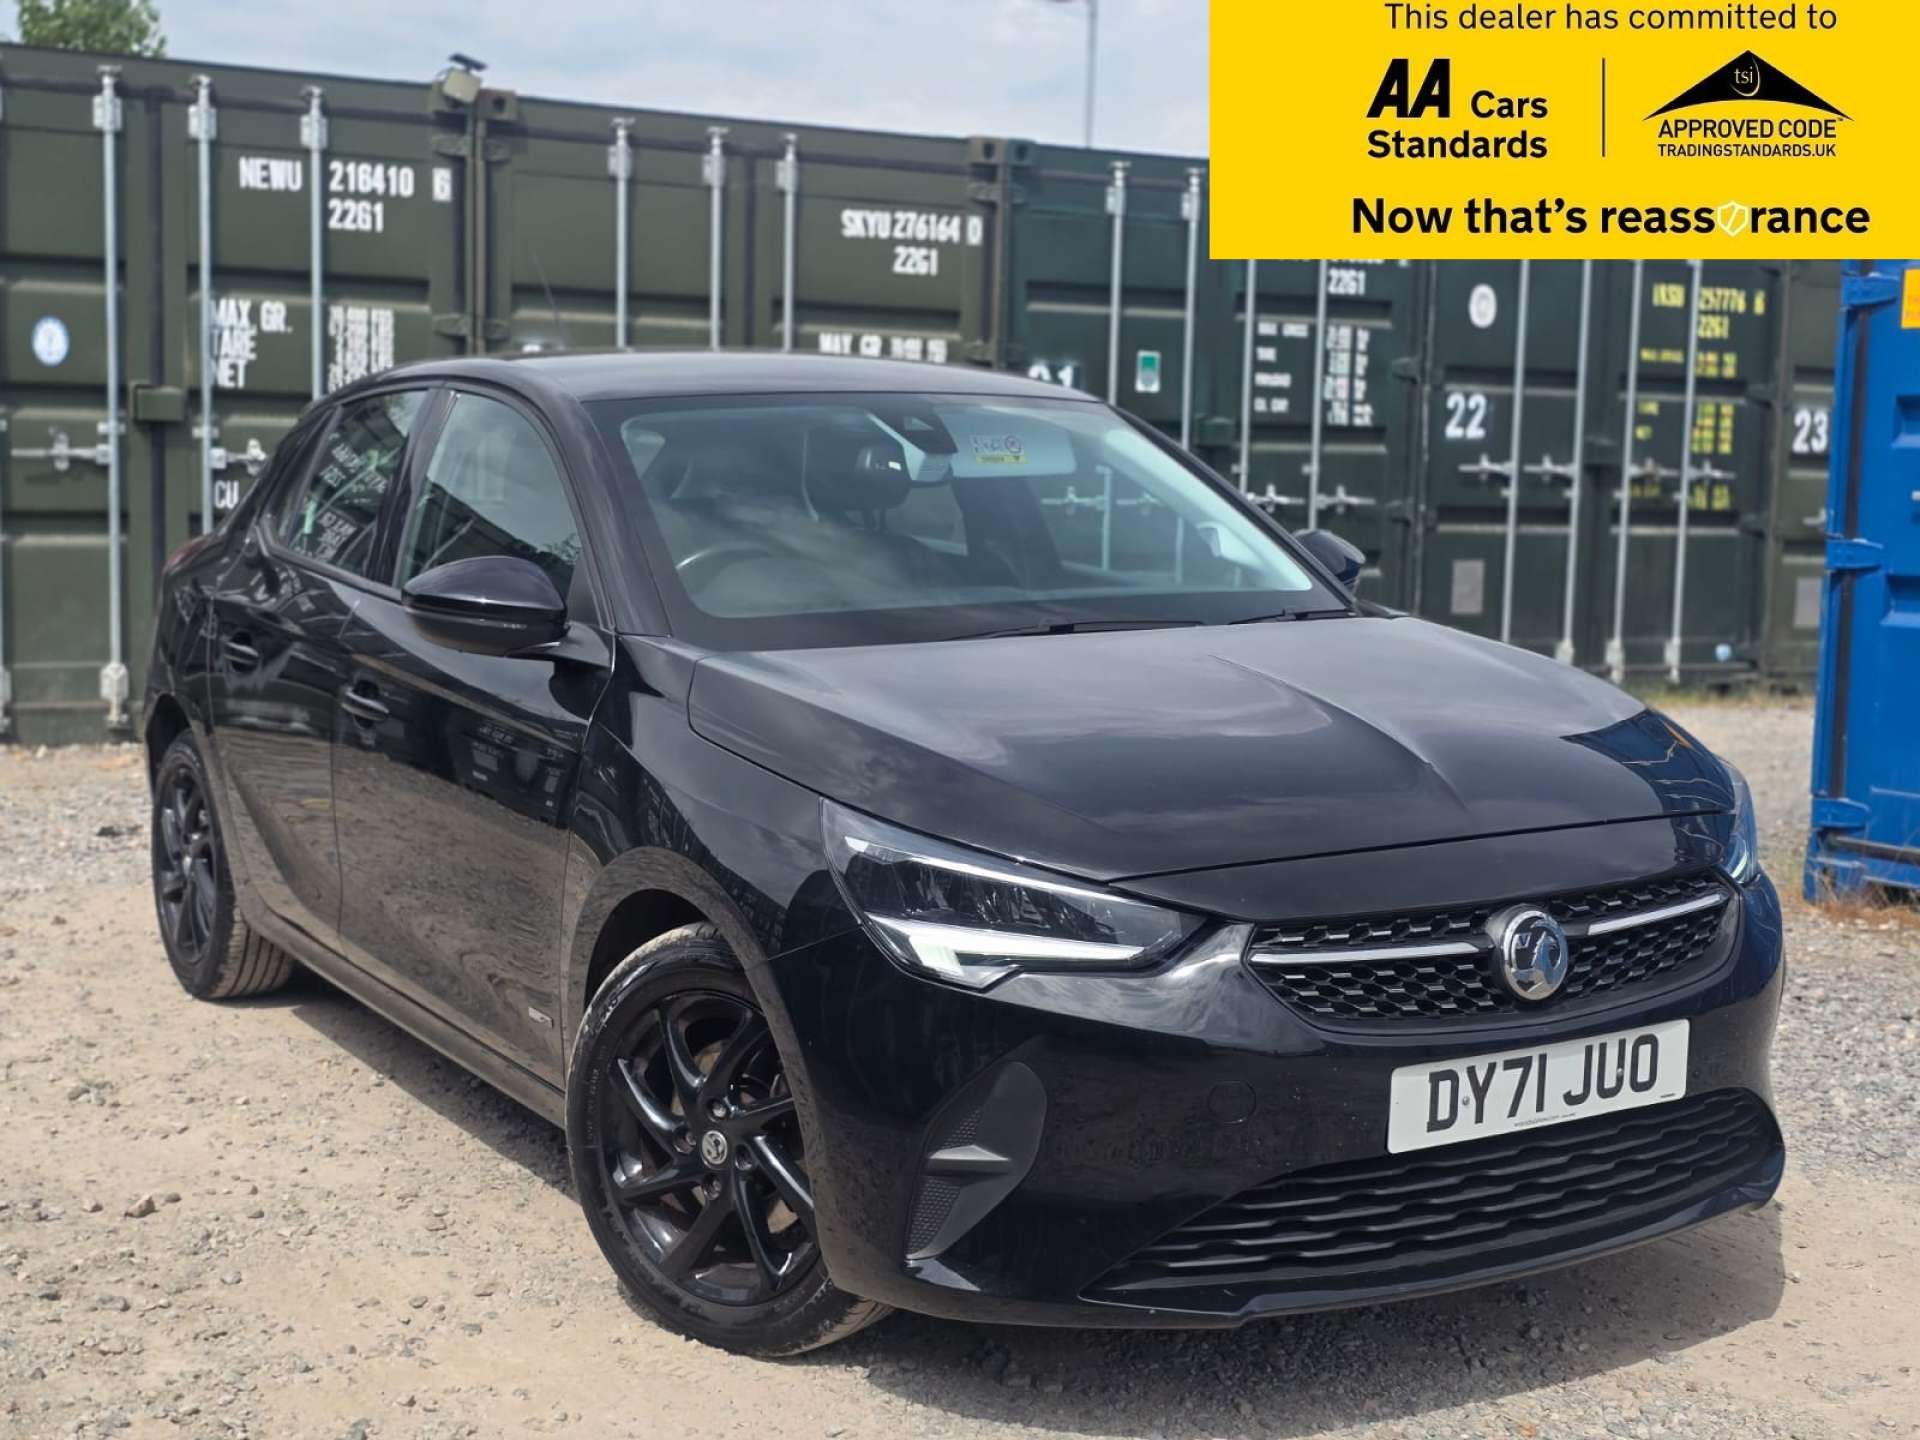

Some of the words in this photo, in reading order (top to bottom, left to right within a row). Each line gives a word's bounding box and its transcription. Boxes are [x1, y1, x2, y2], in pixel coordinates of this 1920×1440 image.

[239, 157, 302, 191] NEWU
[328, 160, 415, 197] 216410
[841, 209, 892, 239] SKYU
[893, 211, 961, 243] 276164
[1445, 392, 1487, 439] 22
[1792, 409, 1829, 453] 23
[1426, 1053, 1548, 1133] DY71
[1562, 1033, 1660, 1107] JUO
